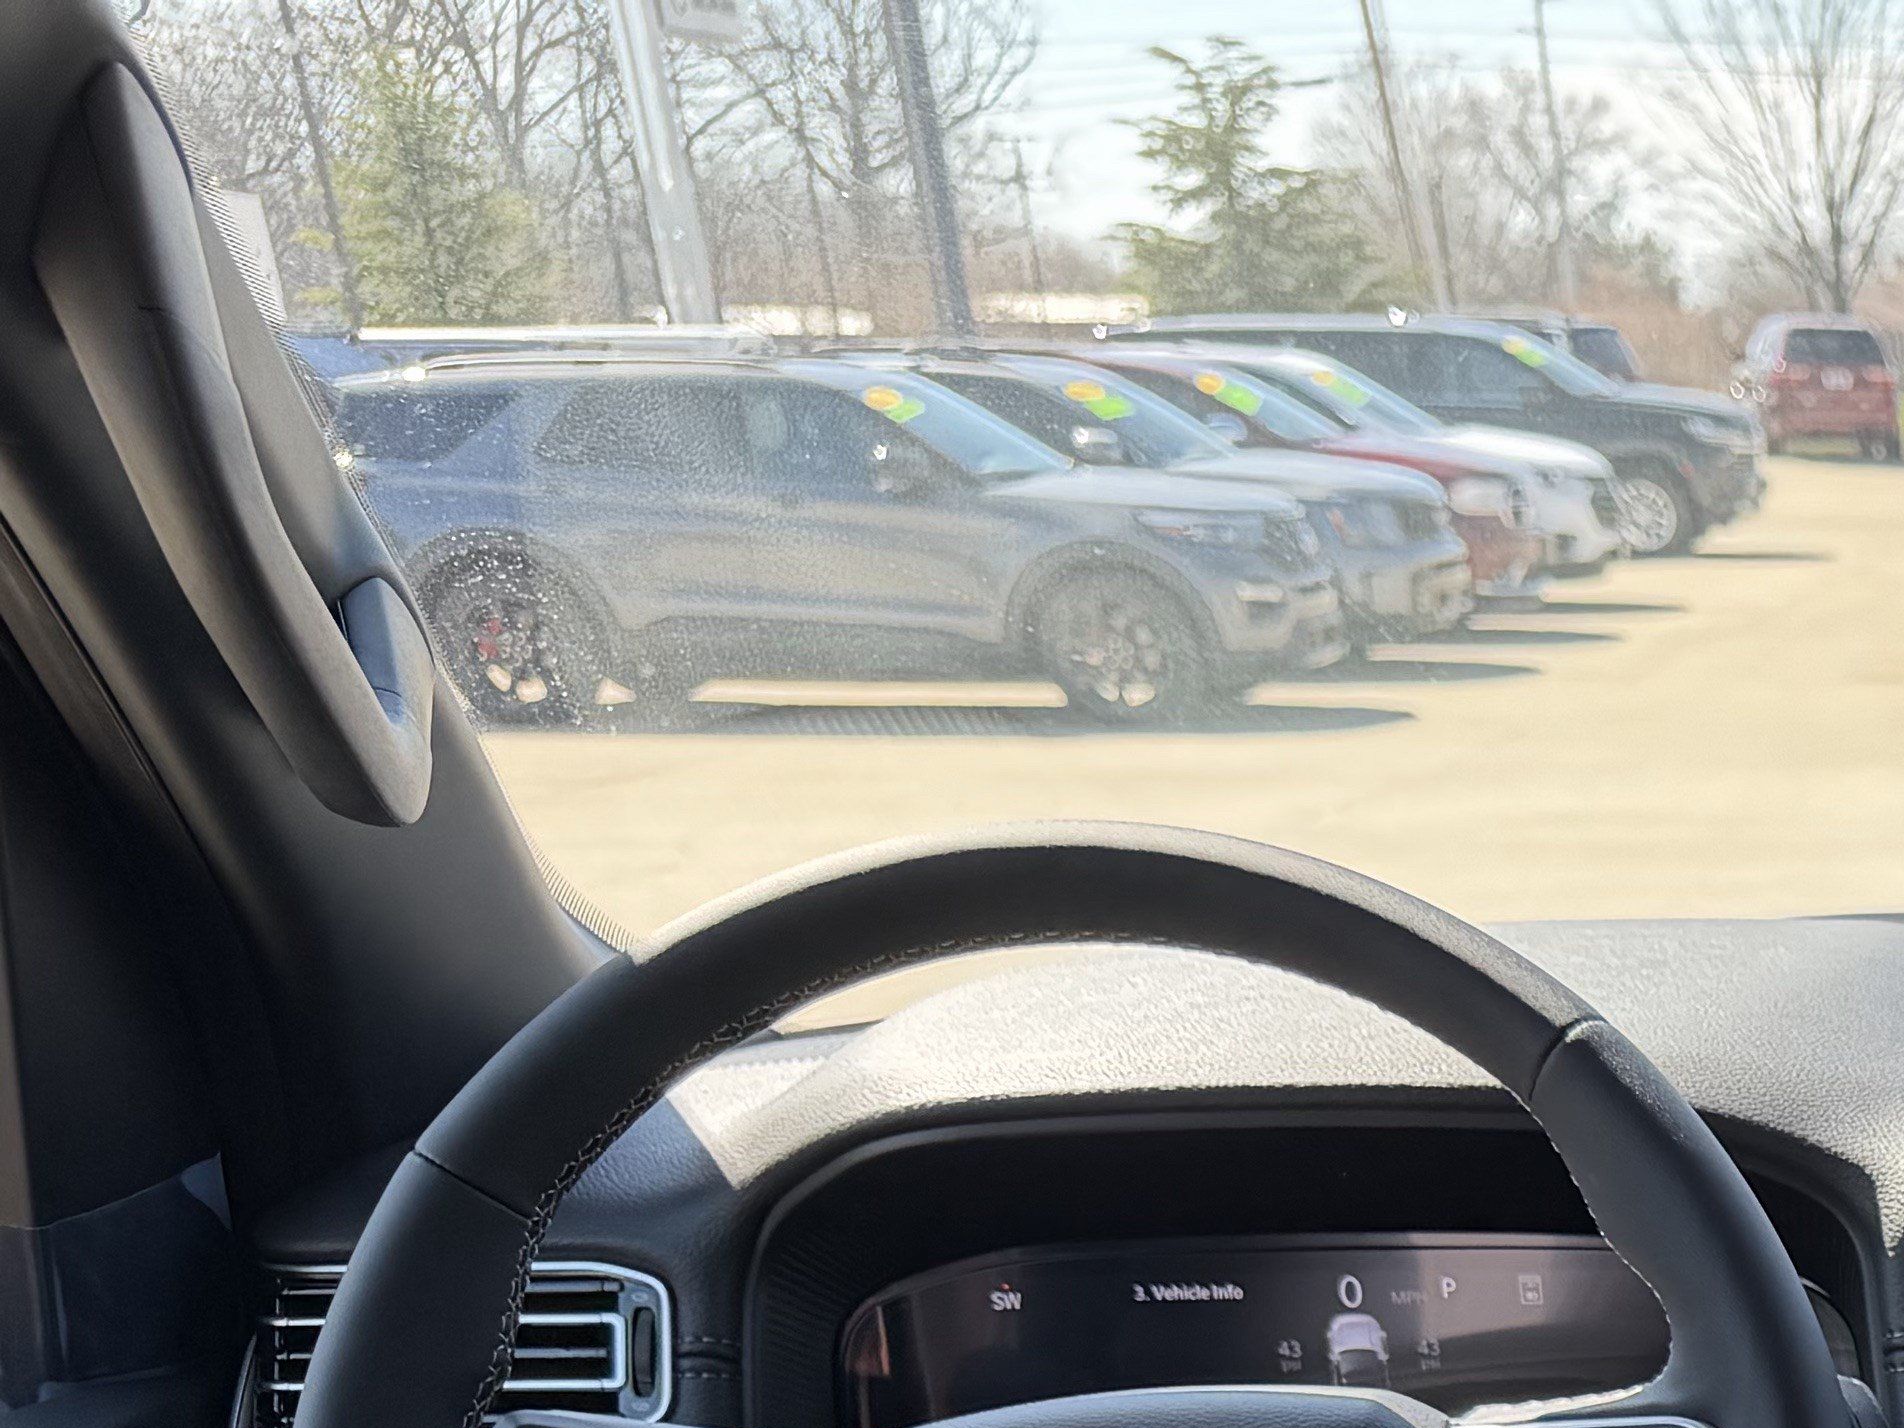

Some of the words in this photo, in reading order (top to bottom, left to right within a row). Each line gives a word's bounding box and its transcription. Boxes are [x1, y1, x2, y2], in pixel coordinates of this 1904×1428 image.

[1149, 1283, 1210, 1301] Vehicle
[1210, 1282, 1244, 1301] Info
[1440, 1276, 1457, 1299] P
